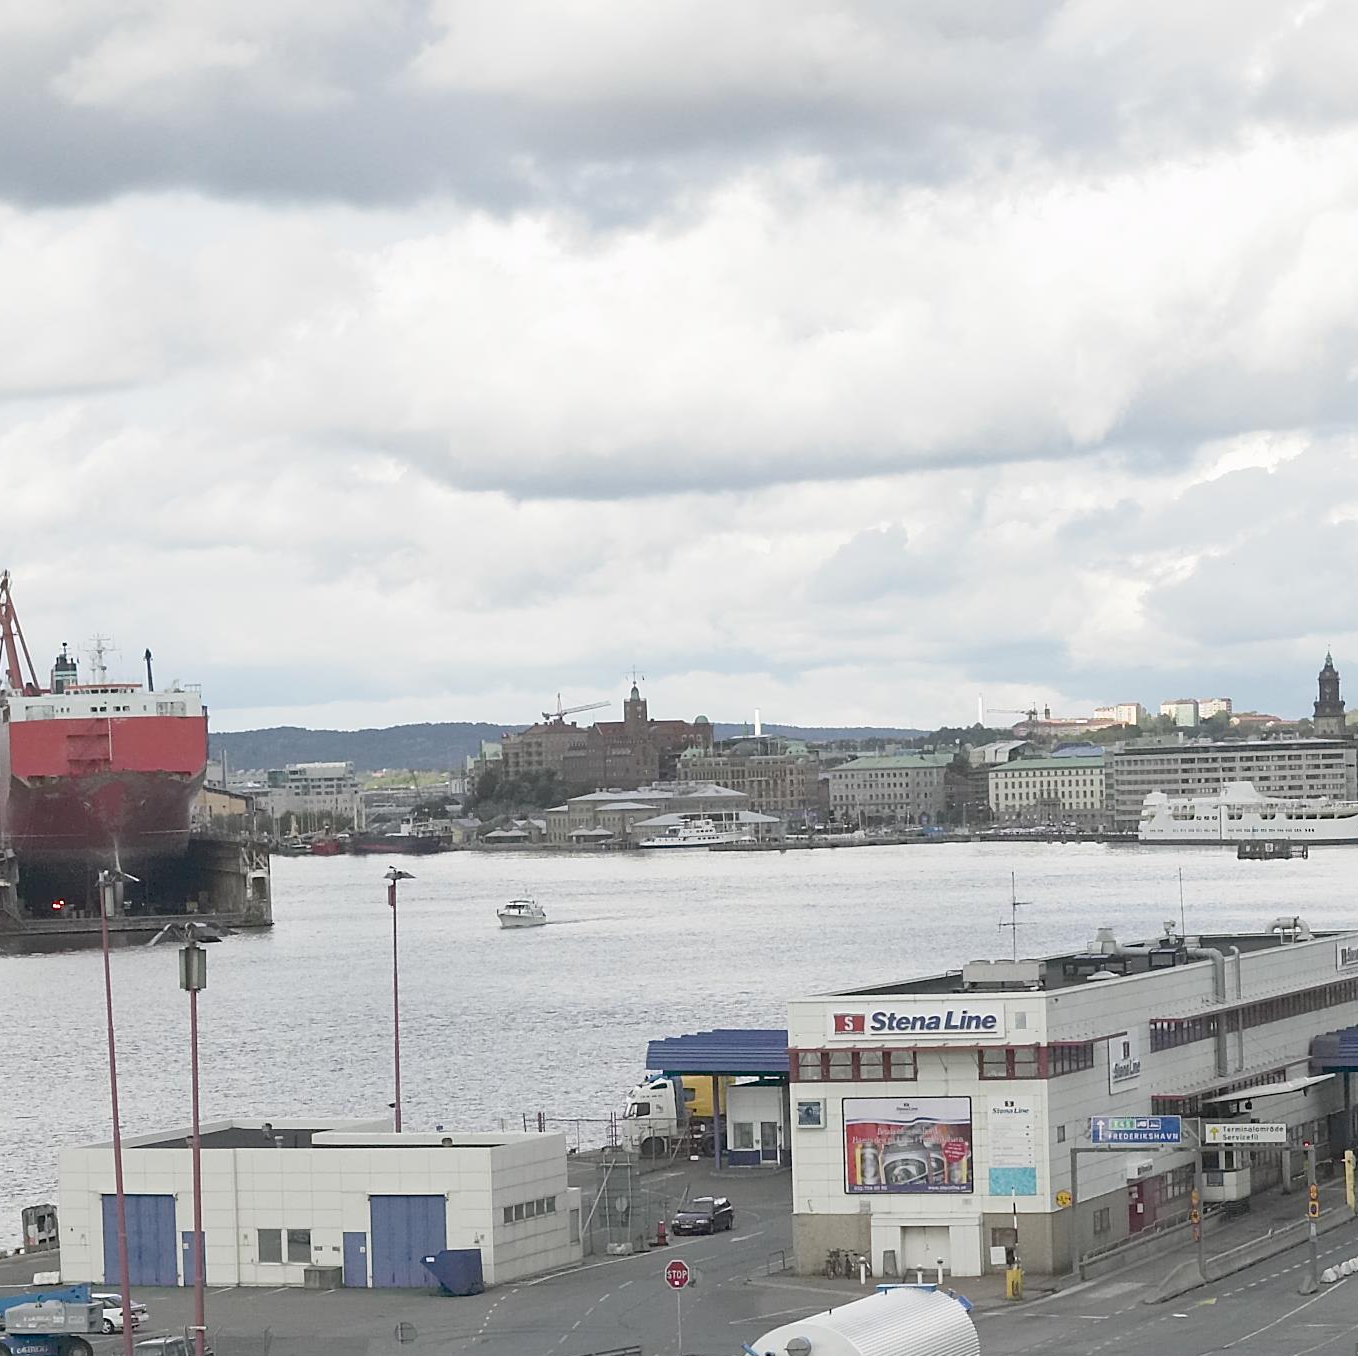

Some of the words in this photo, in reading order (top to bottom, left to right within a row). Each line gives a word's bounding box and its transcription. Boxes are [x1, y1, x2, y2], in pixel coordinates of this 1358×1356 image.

[870, 1011, 941, 1031] Stena
[944, 1010, 997, 1030] Line
[992, 1107, 1012, 1115] Stena
[1222, 1125, 1284, 1134] Terminalområde
[1108, 1132, 1180, 1141] FREDERIKSHAVN
[667, 1270, 688, 1279] STOP
